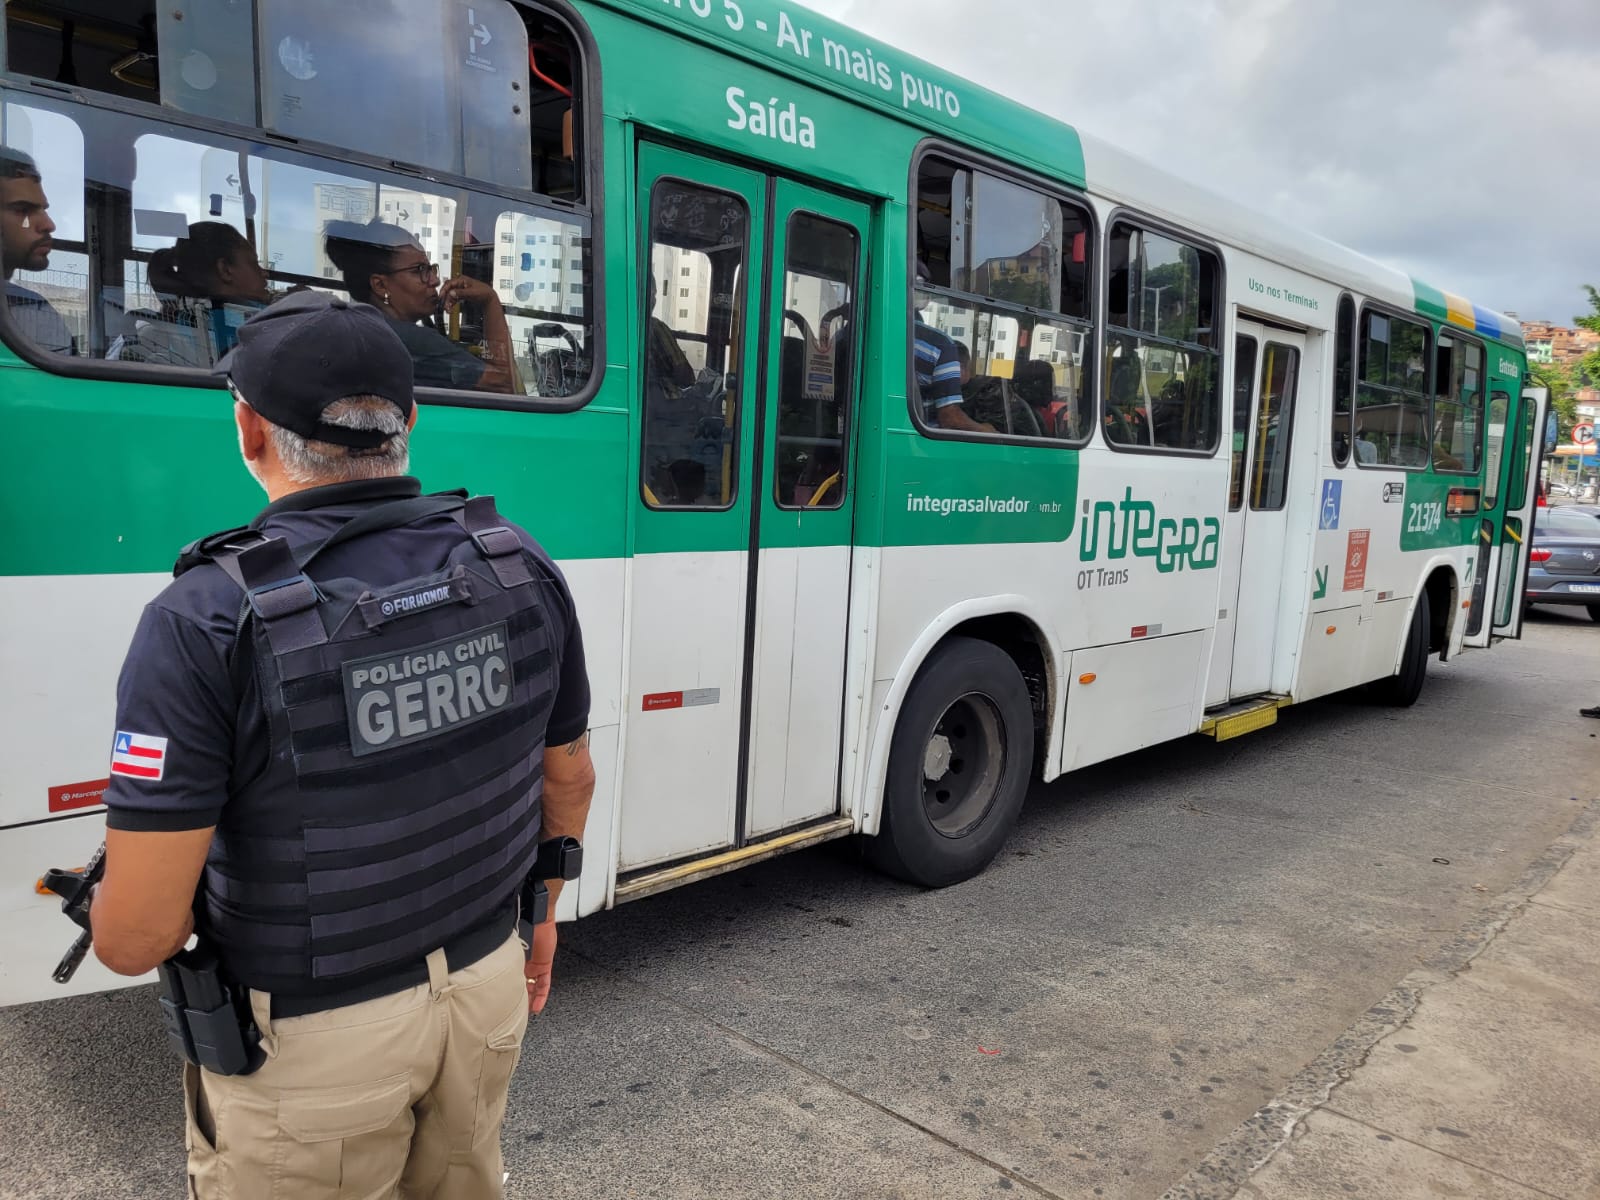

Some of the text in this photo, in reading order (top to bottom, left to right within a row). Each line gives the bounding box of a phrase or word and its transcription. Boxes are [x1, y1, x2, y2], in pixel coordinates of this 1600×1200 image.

[723, 0, 744, 31] 5
[776, 11, 812, 58] Ar
[822, 37, 893, 91] mais
[900, 71, 960, 118] puro
[725, 86, 816, 149] Saída
[1248, 277, 1319, 310] Uso nos Terminais
[1407, 502, 1442, 532] 21374
[1077, 568, 1129, 590] OT Trans
[352, 633, 505, 689] POLÍCIA CIVIL
[356, 655, 509, 745] GERRC
